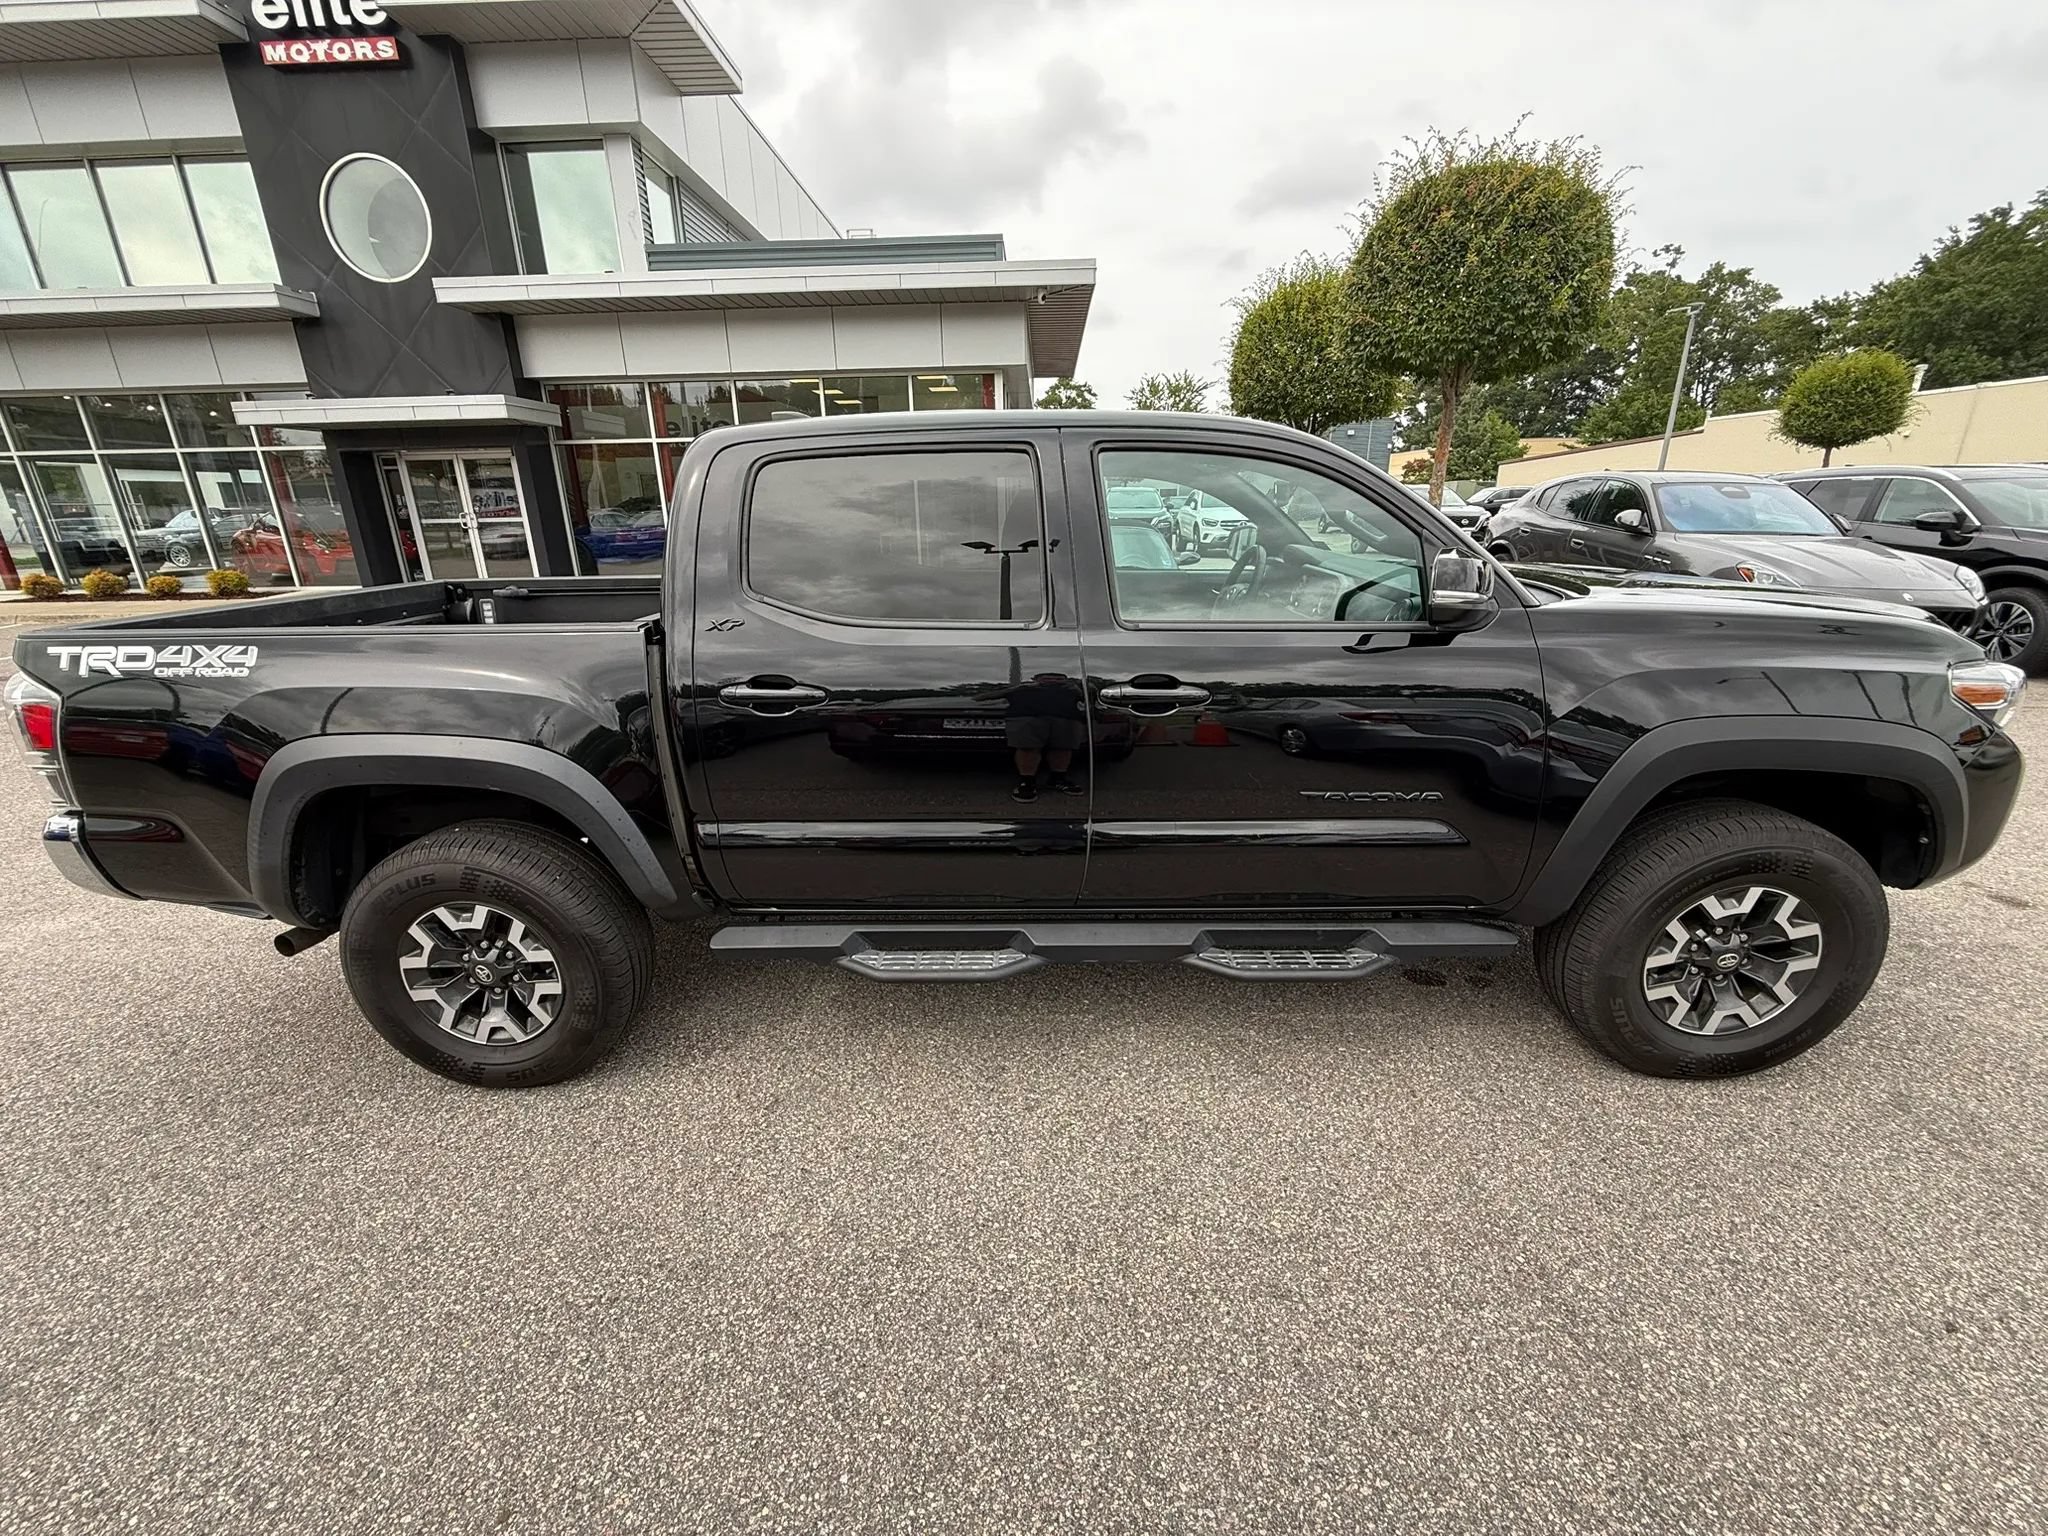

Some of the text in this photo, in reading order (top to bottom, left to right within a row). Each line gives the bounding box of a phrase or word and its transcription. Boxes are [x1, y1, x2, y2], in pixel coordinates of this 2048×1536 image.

[263, 40, 395, 63] MOTORS
[704, 618, 746, 632] XP
[47, 646, 156, 678] TRD
[154, 667, 250, 678] OFF ROAD
[1300, 791, 1444, 802] TACOMA
